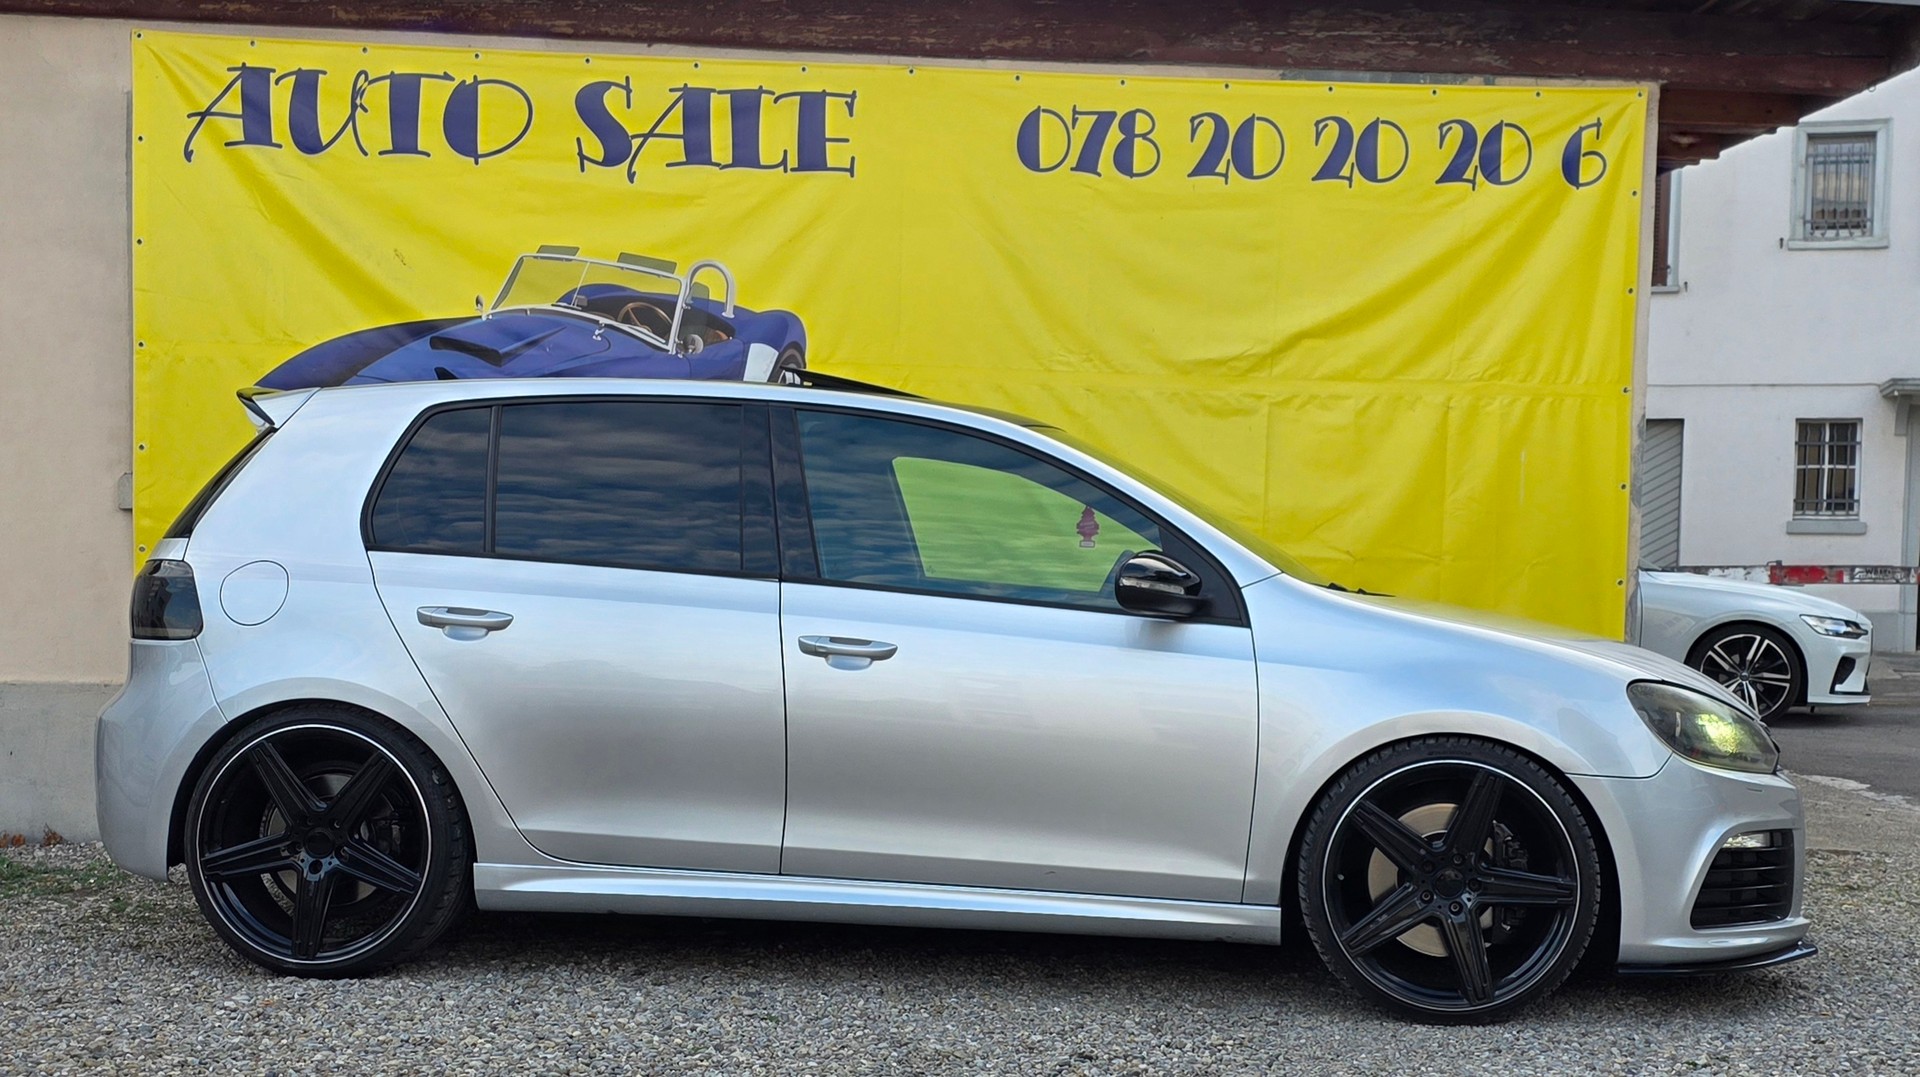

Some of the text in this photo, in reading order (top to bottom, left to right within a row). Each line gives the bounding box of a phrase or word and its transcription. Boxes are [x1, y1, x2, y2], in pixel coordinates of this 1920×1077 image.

[184, 62, 857, 184] AUTO SALE
[1017, 105, 1606, 191] 078 20 20 20 6
